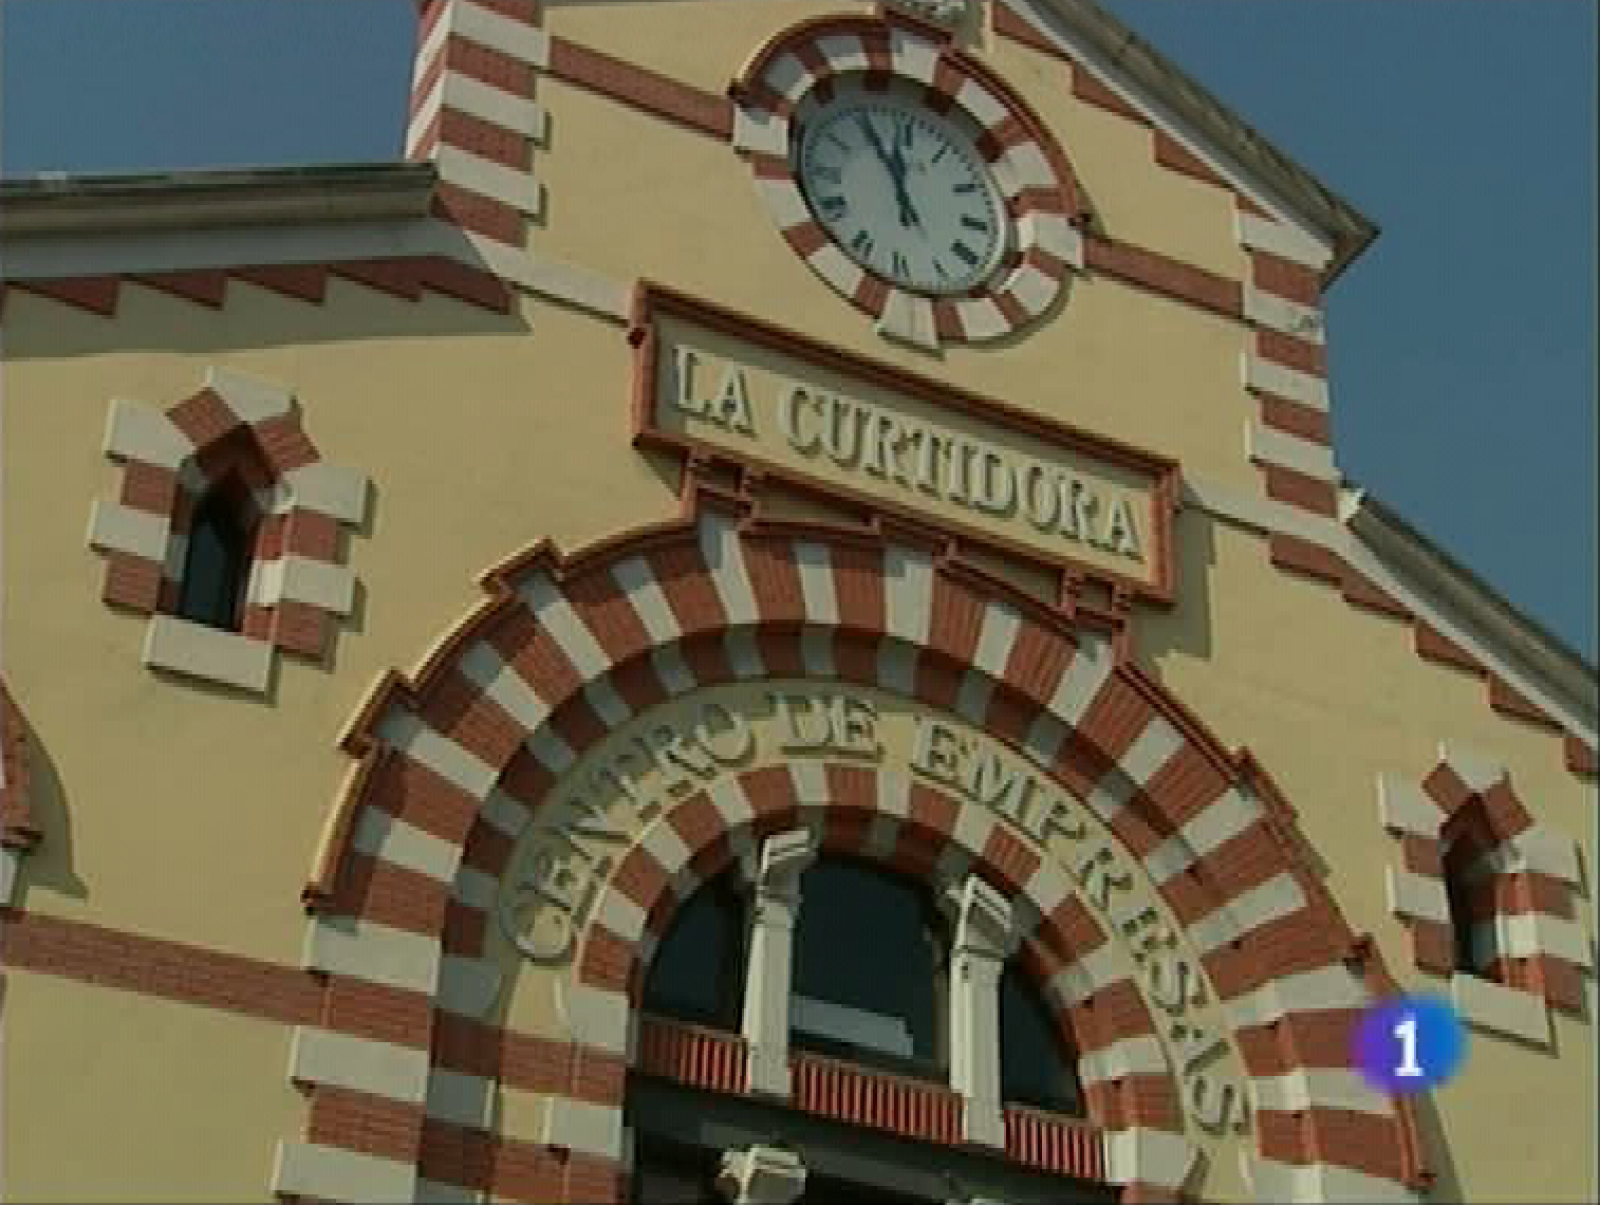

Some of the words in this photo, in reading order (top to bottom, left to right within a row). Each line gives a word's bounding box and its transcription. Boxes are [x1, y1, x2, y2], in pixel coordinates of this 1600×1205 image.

[672, 344, 757, 438] LA
[776, 384, 1145, 564] CURTIDORA
[507, 702, 754, 964] CENTRO
[768, 692, 884, 762] DE
[908, 714, 1252, 1138] EMPRESAS
